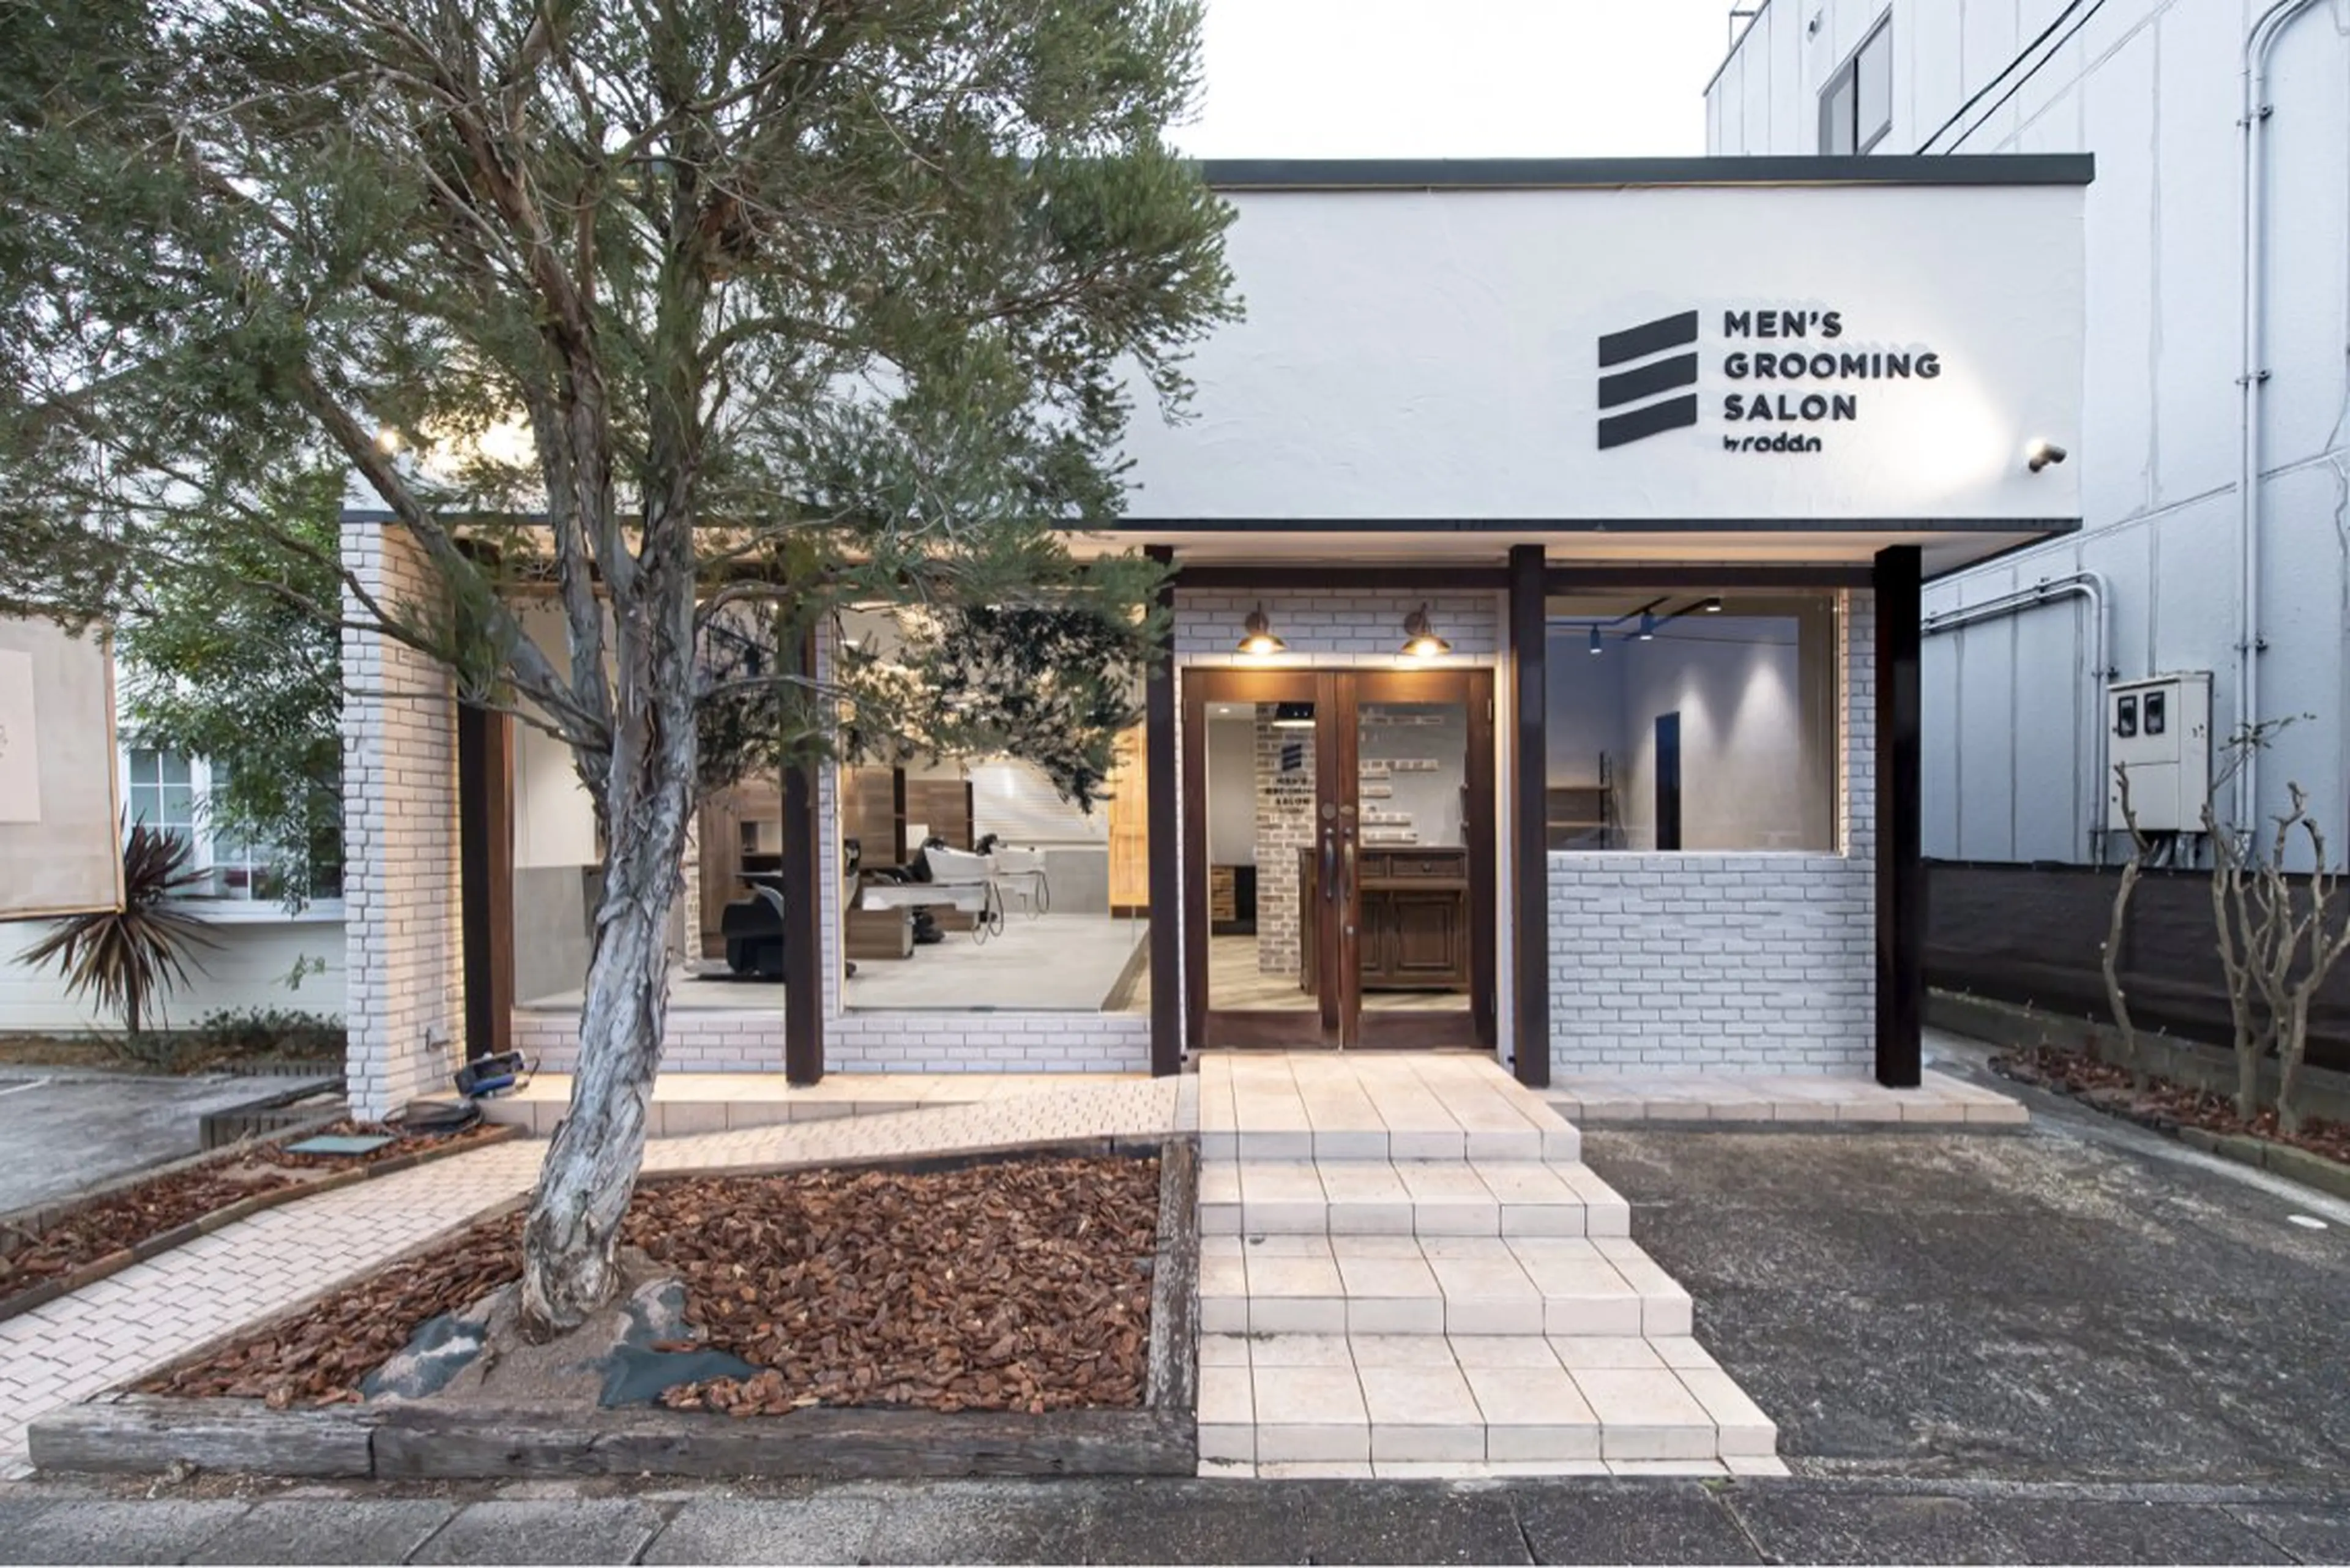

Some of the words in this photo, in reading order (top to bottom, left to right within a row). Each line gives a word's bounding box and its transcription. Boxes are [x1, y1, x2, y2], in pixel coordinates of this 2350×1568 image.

[1724, 310, 1843, 338] MEN'S
[1723, 352, 1941, 379] GROOMING
[1723, 394, 1857, 421] SALON
